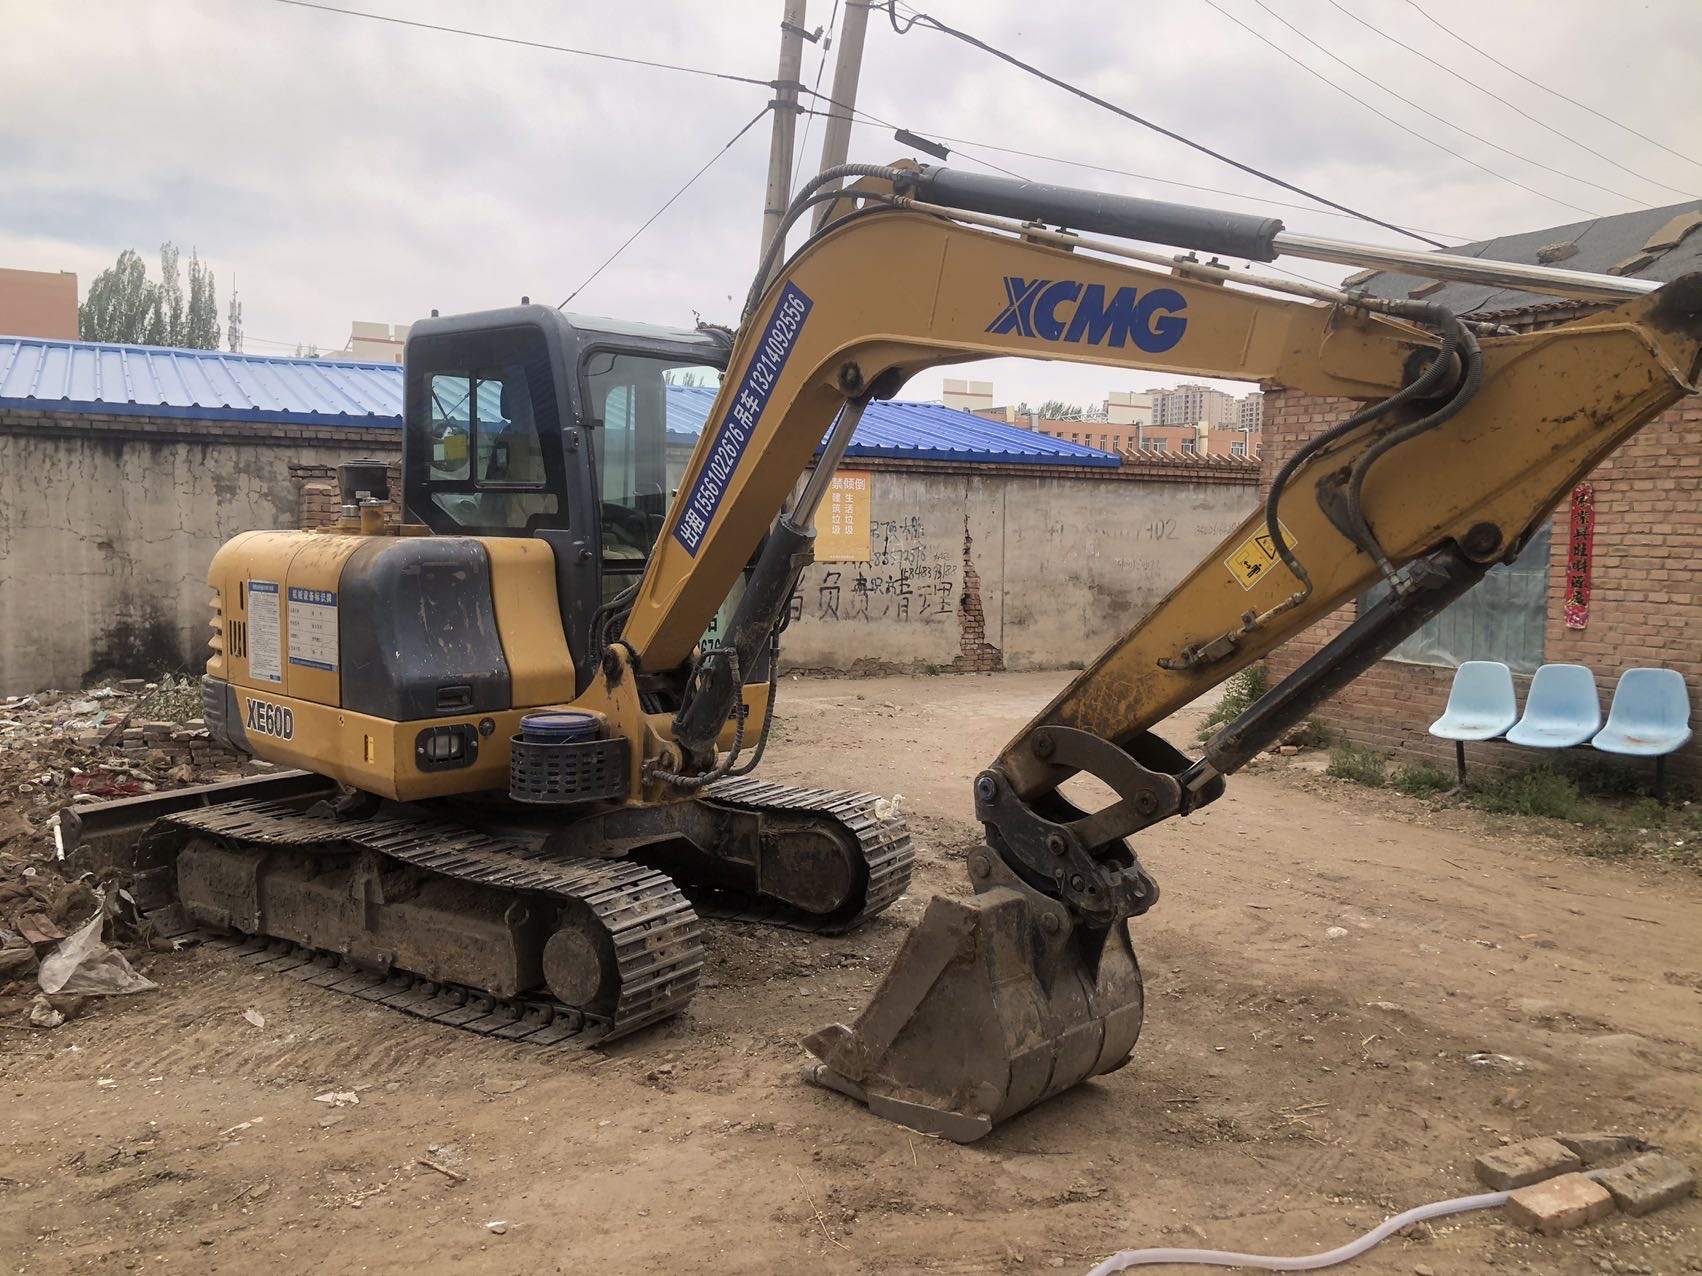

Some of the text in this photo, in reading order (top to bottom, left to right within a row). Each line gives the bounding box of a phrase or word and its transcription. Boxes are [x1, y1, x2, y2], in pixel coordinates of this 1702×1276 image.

[984, 276, 1188, 353] XCMG
[680, 293, 805, 548] 出租 15561022676 吊车 13214092556
[845, 493, 854, 535] 生活垃圾
[246, 697, 294, 740] XE60D
